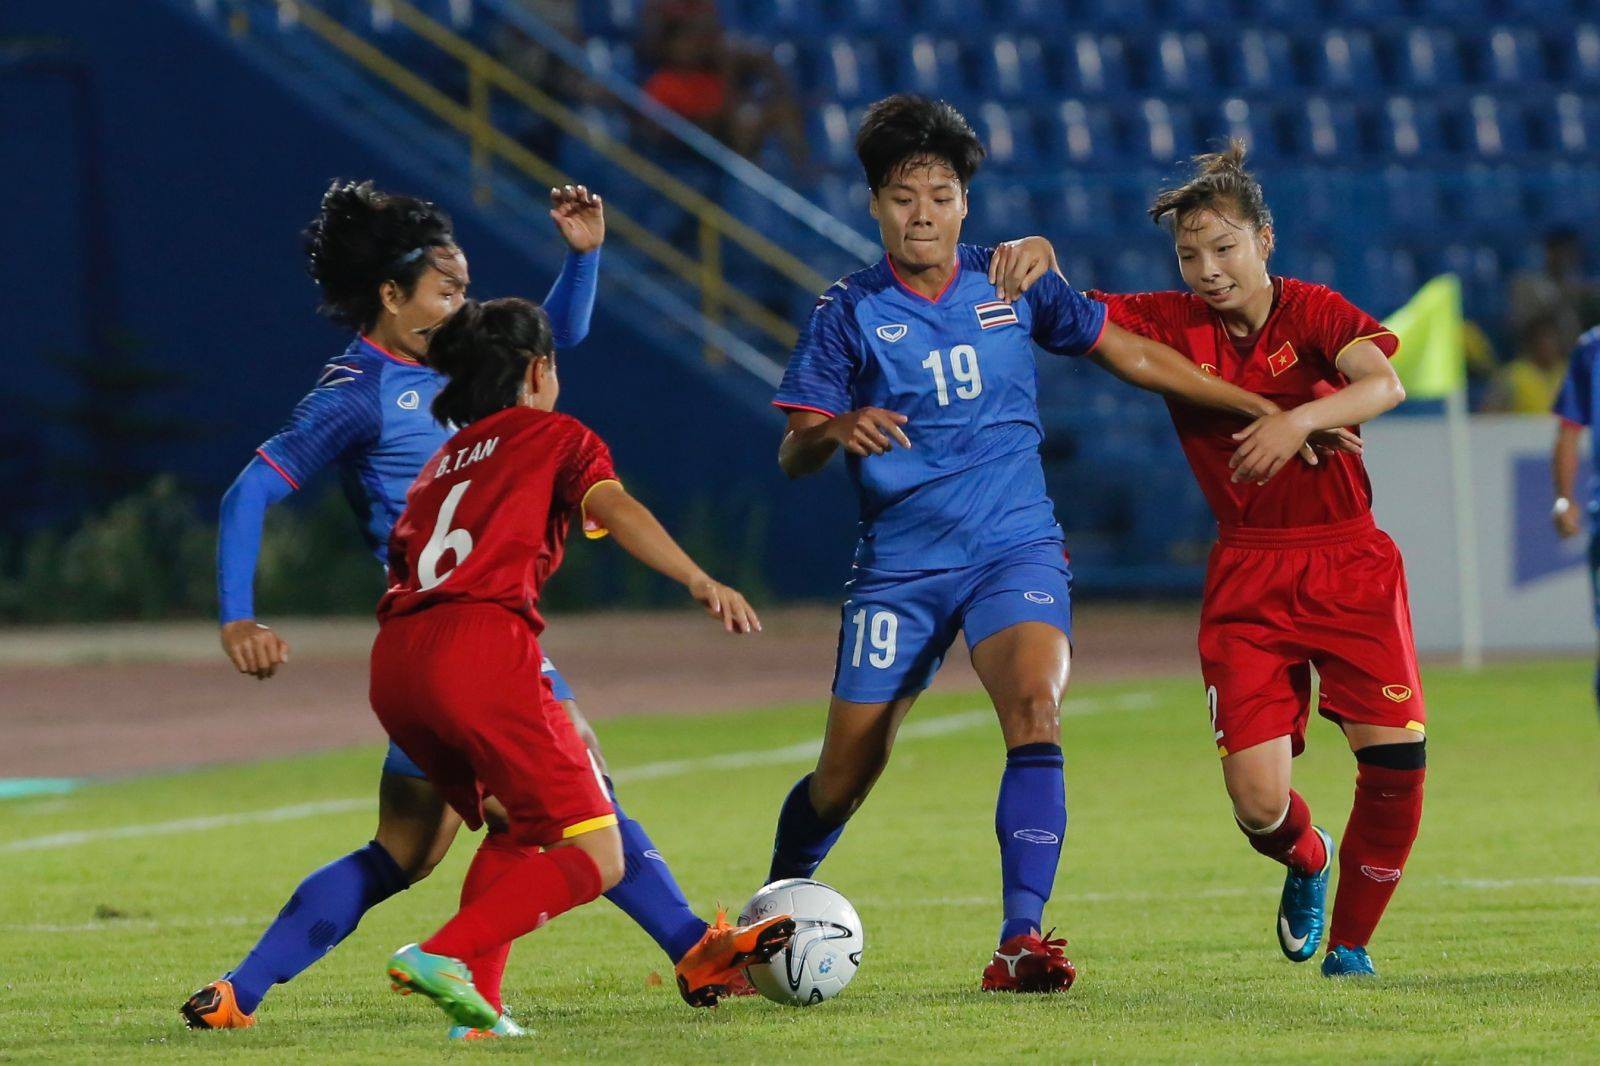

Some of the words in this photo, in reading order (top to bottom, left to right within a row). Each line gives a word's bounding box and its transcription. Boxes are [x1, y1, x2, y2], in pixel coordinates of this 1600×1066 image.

[922, 344, 982, 406] 19
[417, 479, 473, 592] 6
[852, 608, 898, 669] 19
